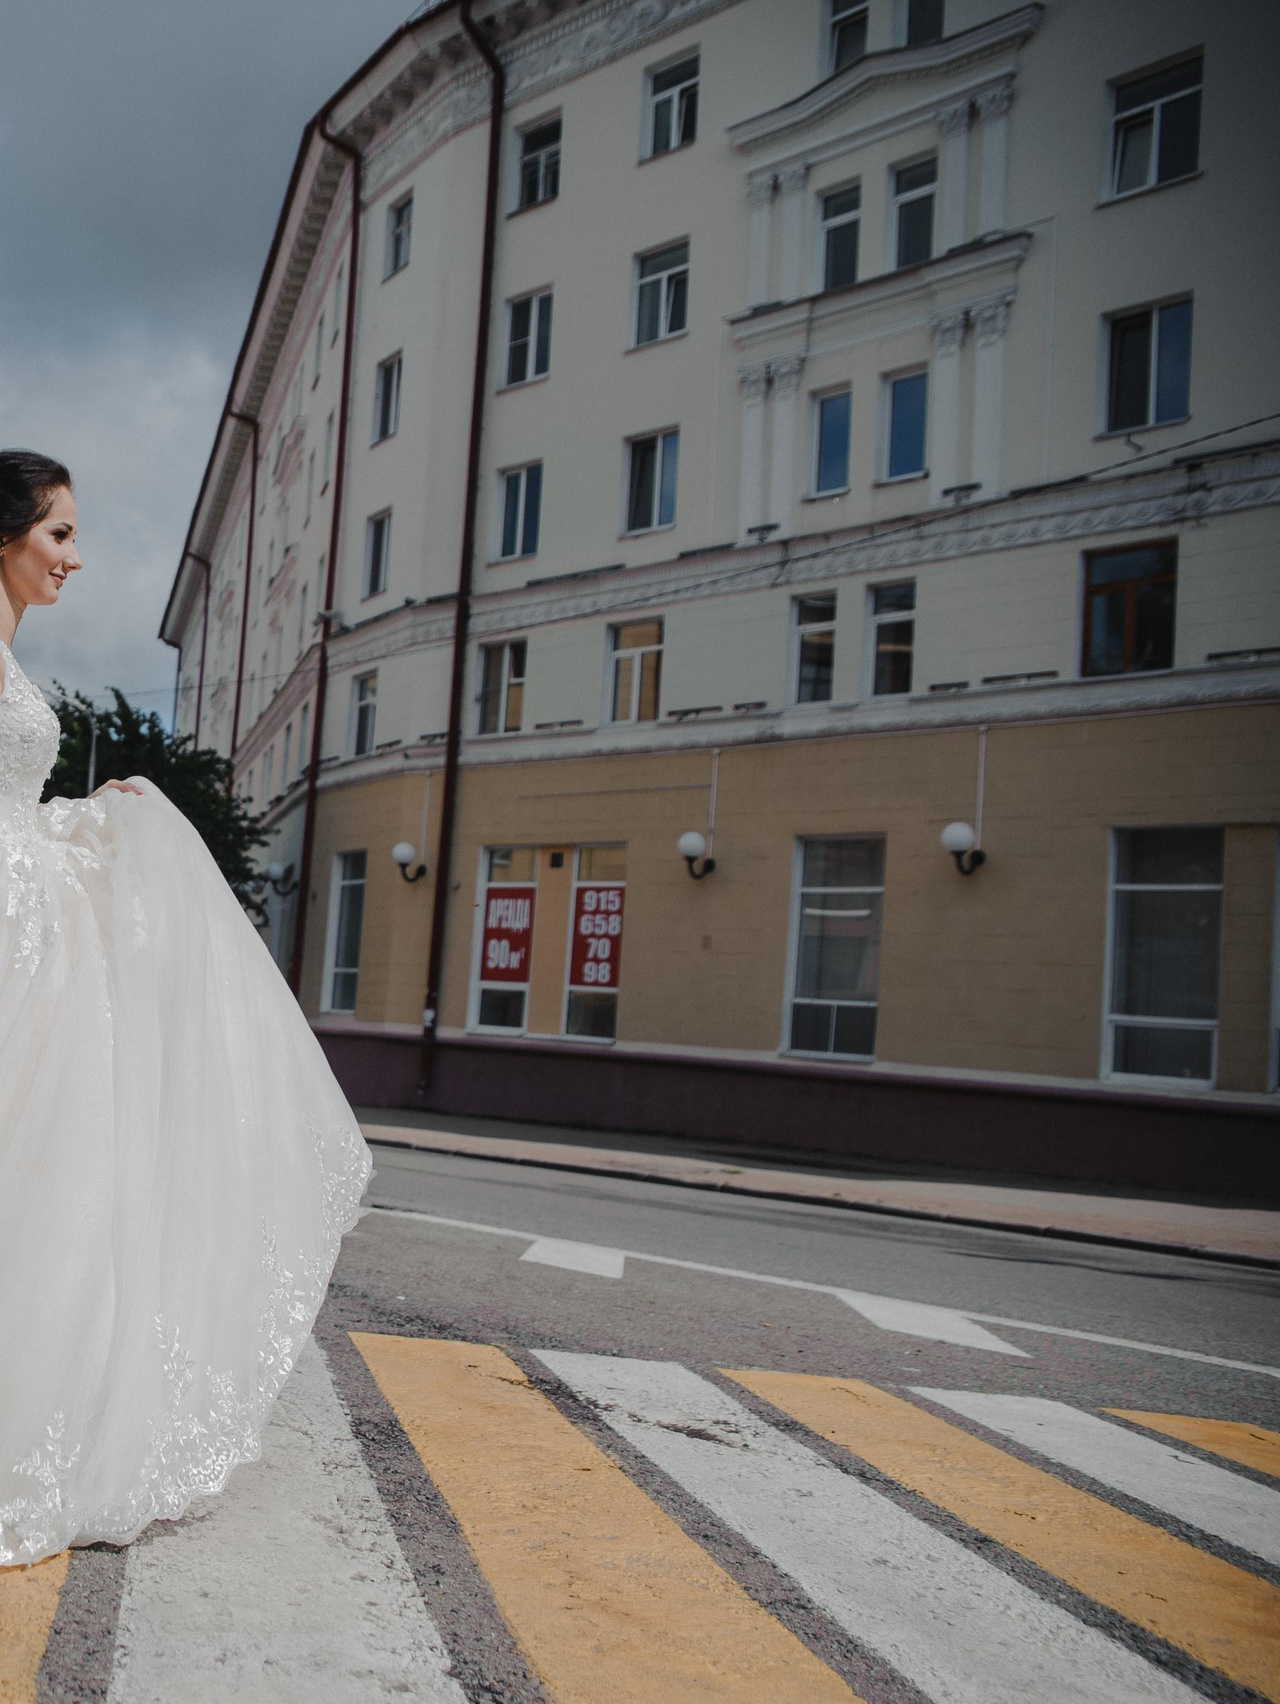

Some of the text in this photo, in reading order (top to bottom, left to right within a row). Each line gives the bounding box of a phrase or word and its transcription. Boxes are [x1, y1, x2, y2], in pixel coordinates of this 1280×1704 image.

[584, 890, 621, 911] 915
[487, 898, 531, 932] АРЕНДА
[580, 914, 622, 935] 658
[587, 938, 611, 959] 70
[583, 962, 611, 983] 98
